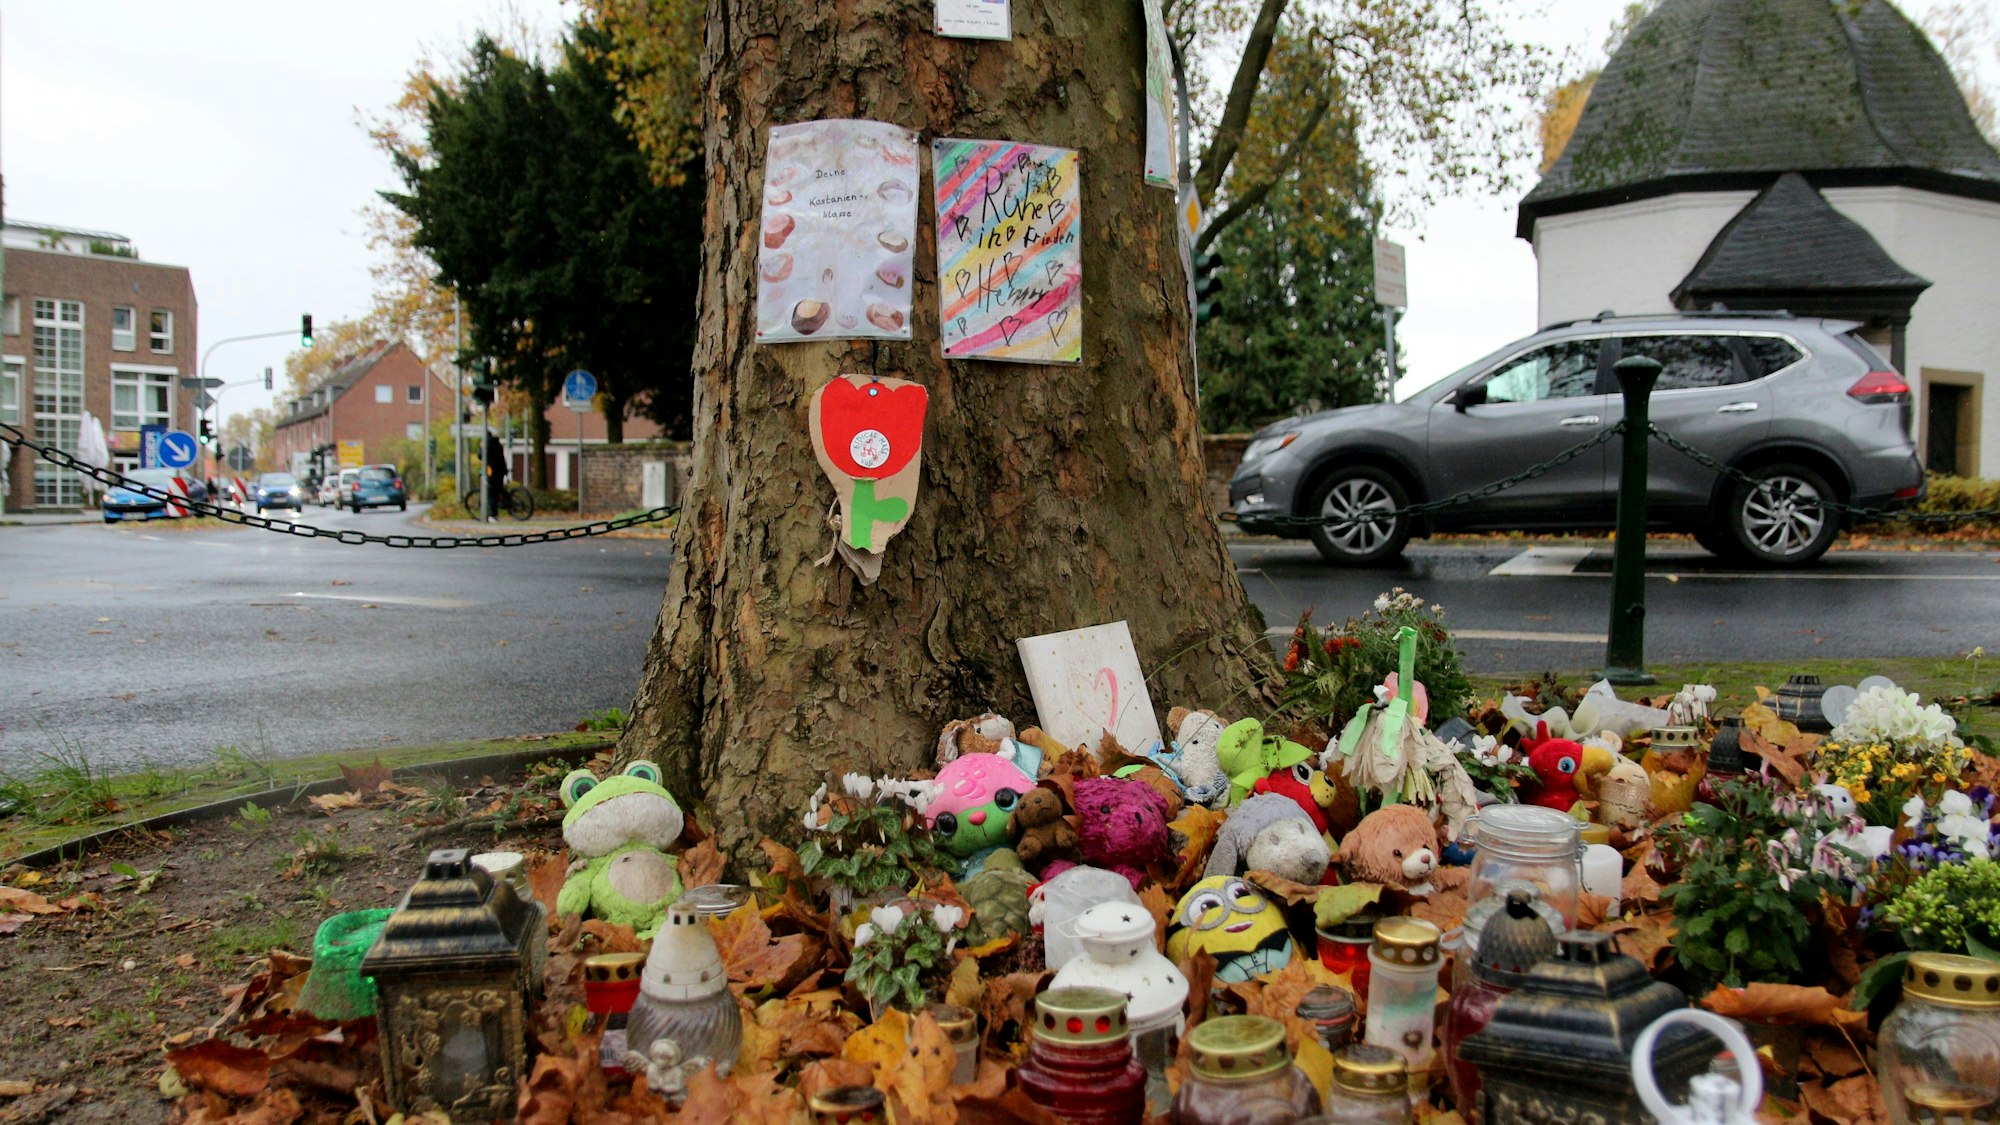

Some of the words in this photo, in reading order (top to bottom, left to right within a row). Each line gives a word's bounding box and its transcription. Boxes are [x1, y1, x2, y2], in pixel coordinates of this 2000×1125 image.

[815, 169, 846, 179] Deine
[982, 165, 1043, 224] Ruhe
[979, 228, 1002, 249] in
[1023, 225, 1075, 248] Frieden
